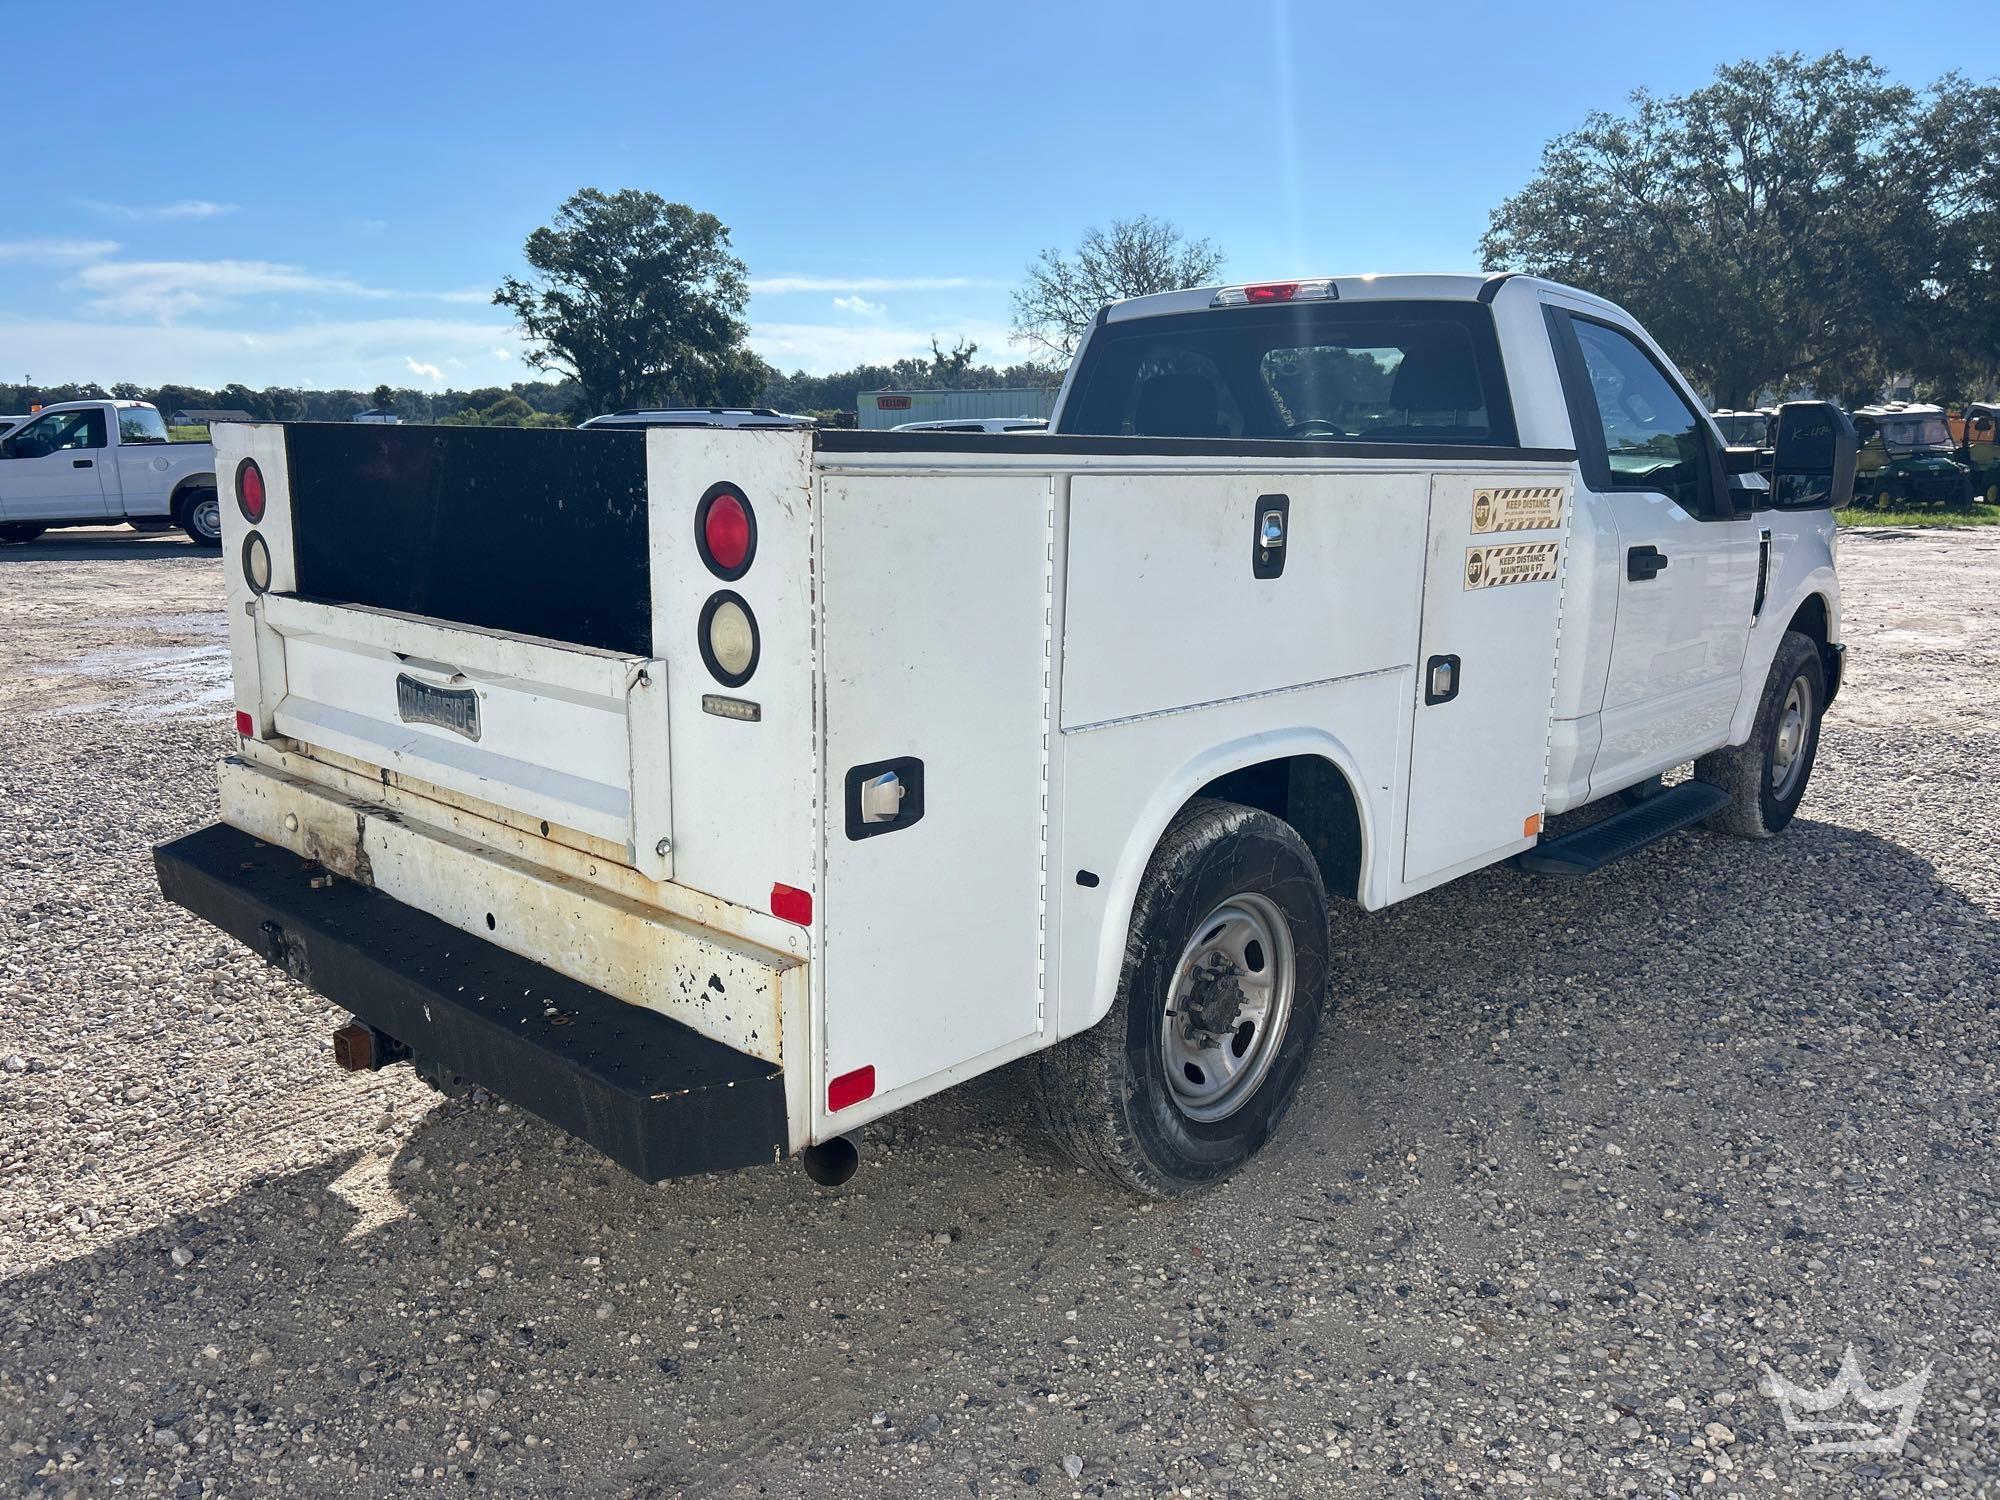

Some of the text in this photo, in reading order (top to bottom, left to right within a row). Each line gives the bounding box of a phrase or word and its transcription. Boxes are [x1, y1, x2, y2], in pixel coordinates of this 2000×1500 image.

[881, 398, 908, 408] YELLOW
[1506, 498, 1551, 510] KEEP DISTANCE
[1476, 505, 1489, 518] 6FT
[1499, 553, 1546, 566] KEEP DISTANCE
[1469, 562, 1482, 575] 6FT
[1500, 563, 1543, 575] MAINTAIN 6 FT
